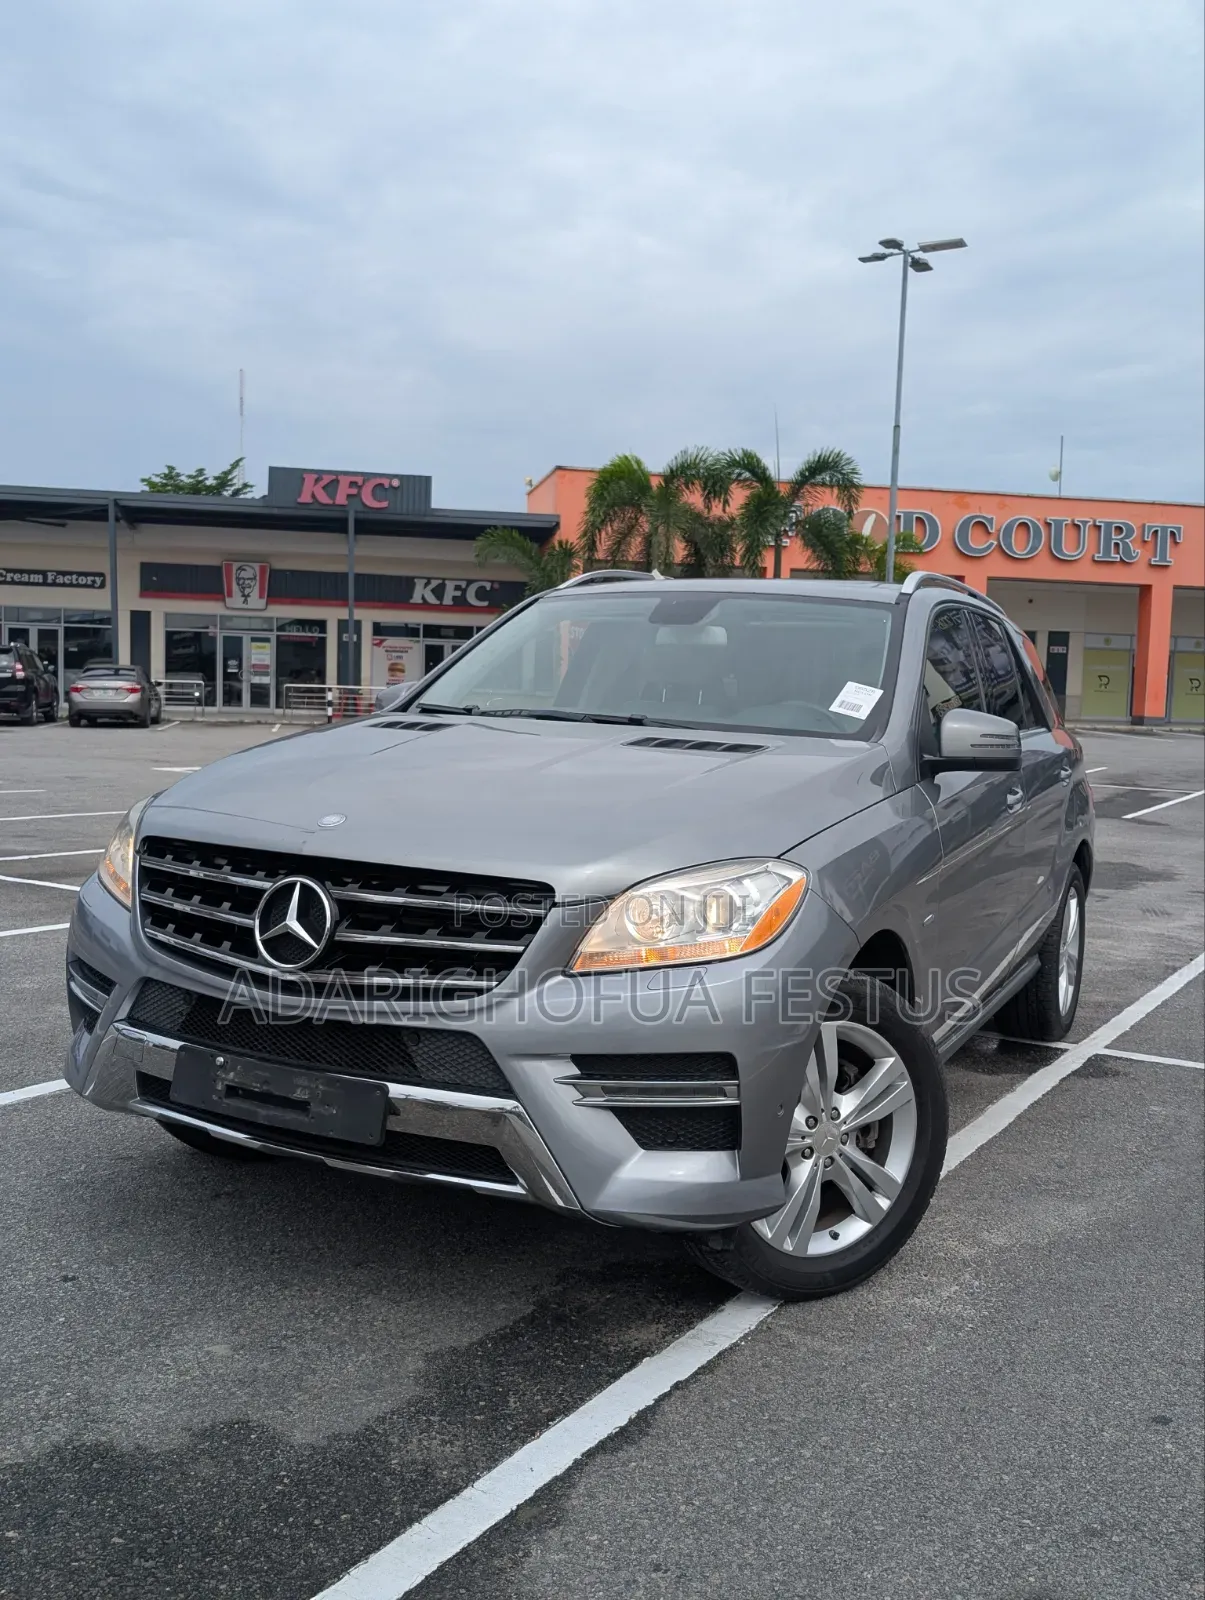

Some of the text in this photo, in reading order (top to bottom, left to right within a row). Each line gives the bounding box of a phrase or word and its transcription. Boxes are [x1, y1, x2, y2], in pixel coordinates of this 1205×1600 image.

[954, 514, 1184, 566] COURT
[0, 569, 103, 587] Cream Factory
[570, 626, 585, 640] STO
